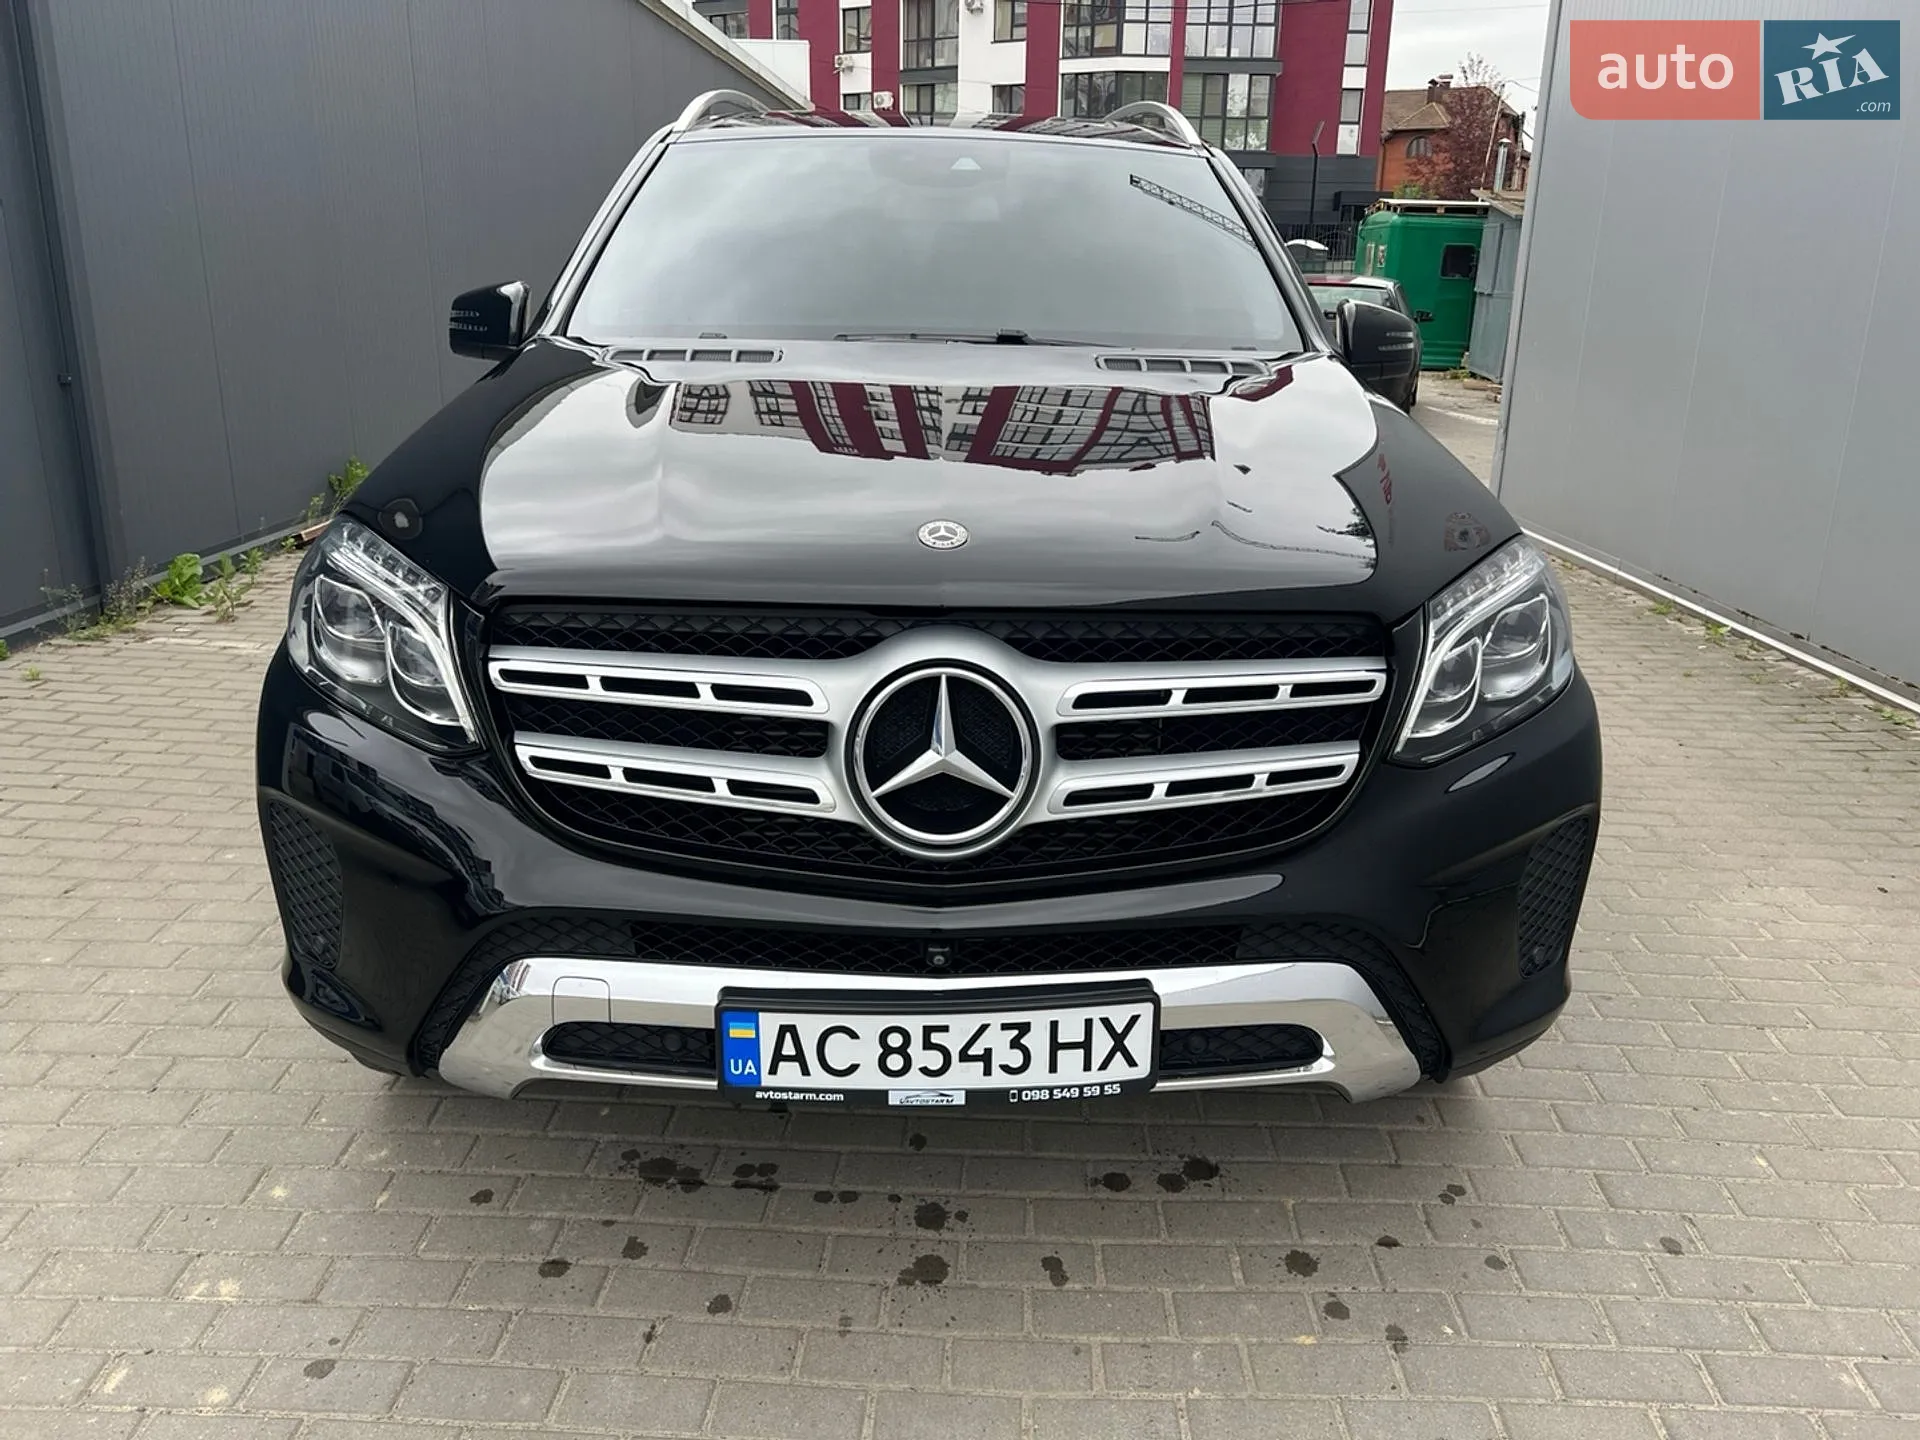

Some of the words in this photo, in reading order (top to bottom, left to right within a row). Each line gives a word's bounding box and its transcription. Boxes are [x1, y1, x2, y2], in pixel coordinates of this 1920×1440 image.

[767, 1023, 861, 1077] AC
[877, 1022, 1032, 1078] 8543
[1047, 1014, 1142, 1075] HX
[730, 1059, 757, 1076] UA
[755, 1090, 844, 1101] avtostarm.com
[1021, 1089, 1050, 1101] 098
[1052, 1087, 1079, 1099] 549
[1083, 1085, 1100, 1097] 59
[1103, 1083, 1121, 1095] 55
